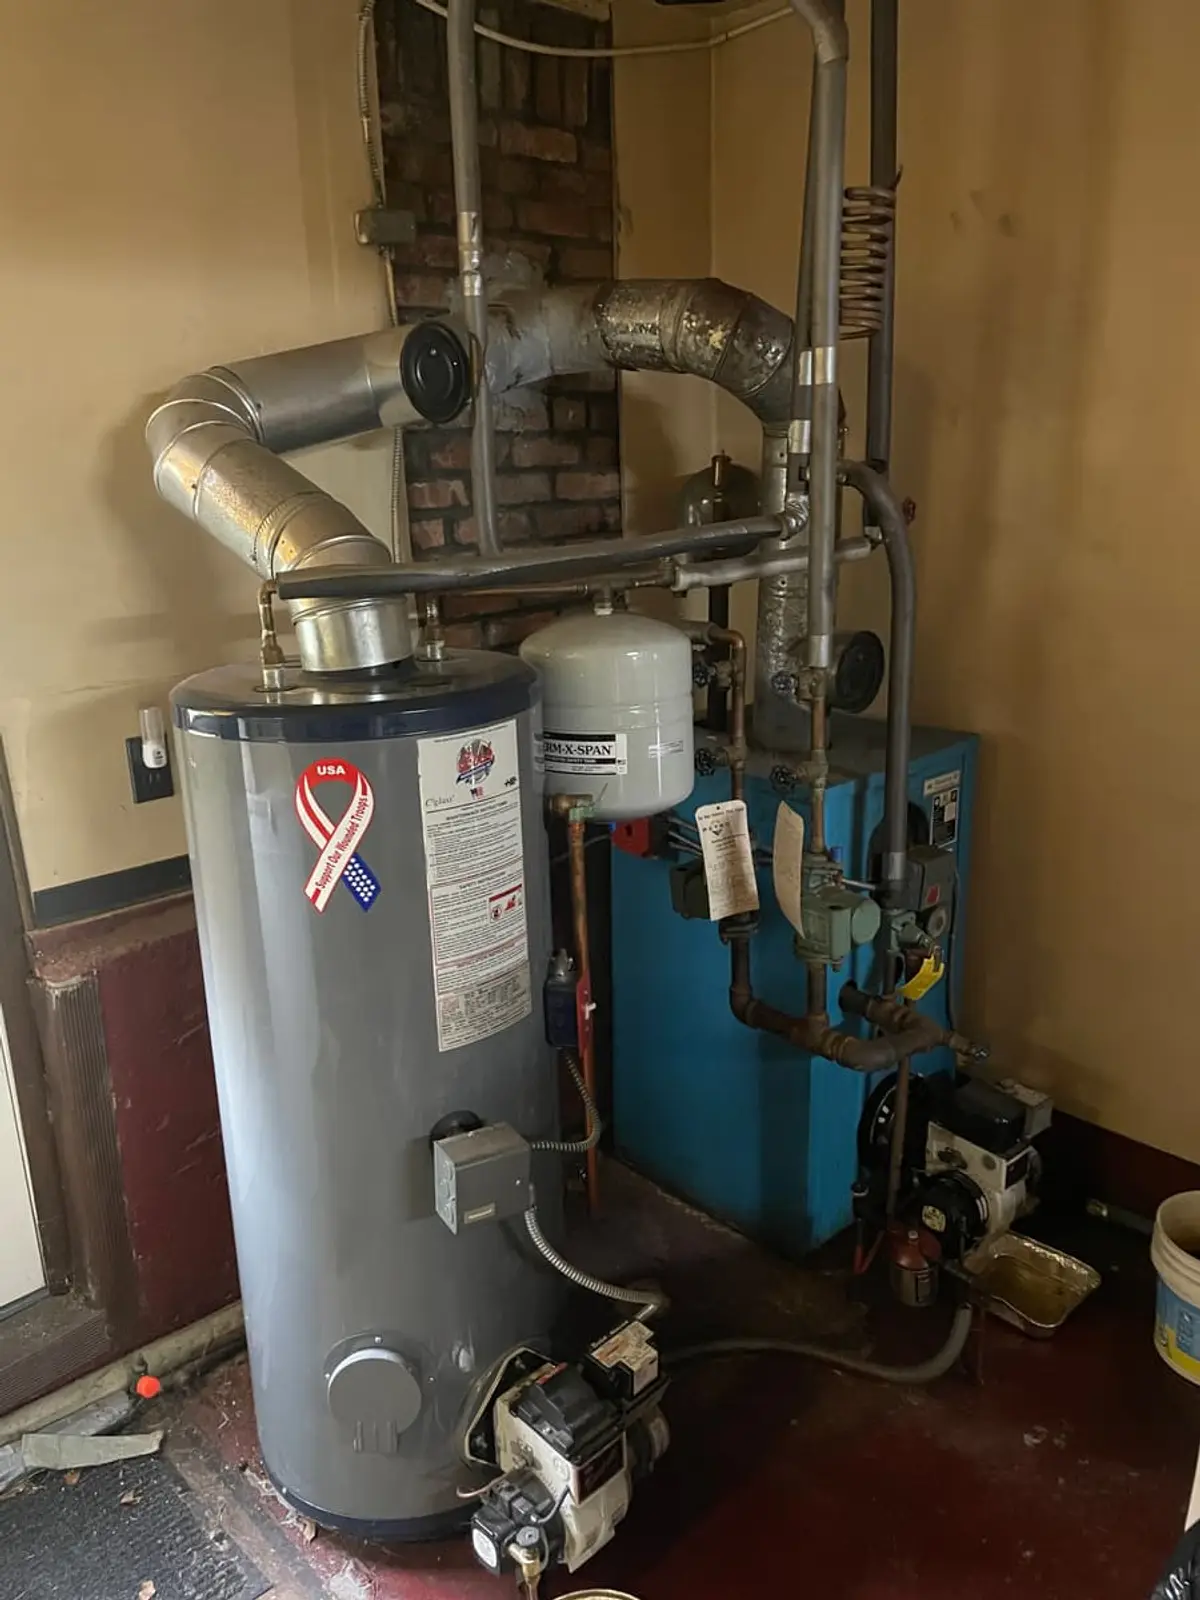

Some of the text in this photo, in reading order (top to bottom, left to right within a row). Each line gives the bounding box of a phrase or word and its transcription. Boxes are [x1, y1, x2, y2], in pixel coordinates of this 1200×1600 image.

[317, 765, 346, 776] USA
[315, 798, 368, 889] Support Our Wounded Troops
